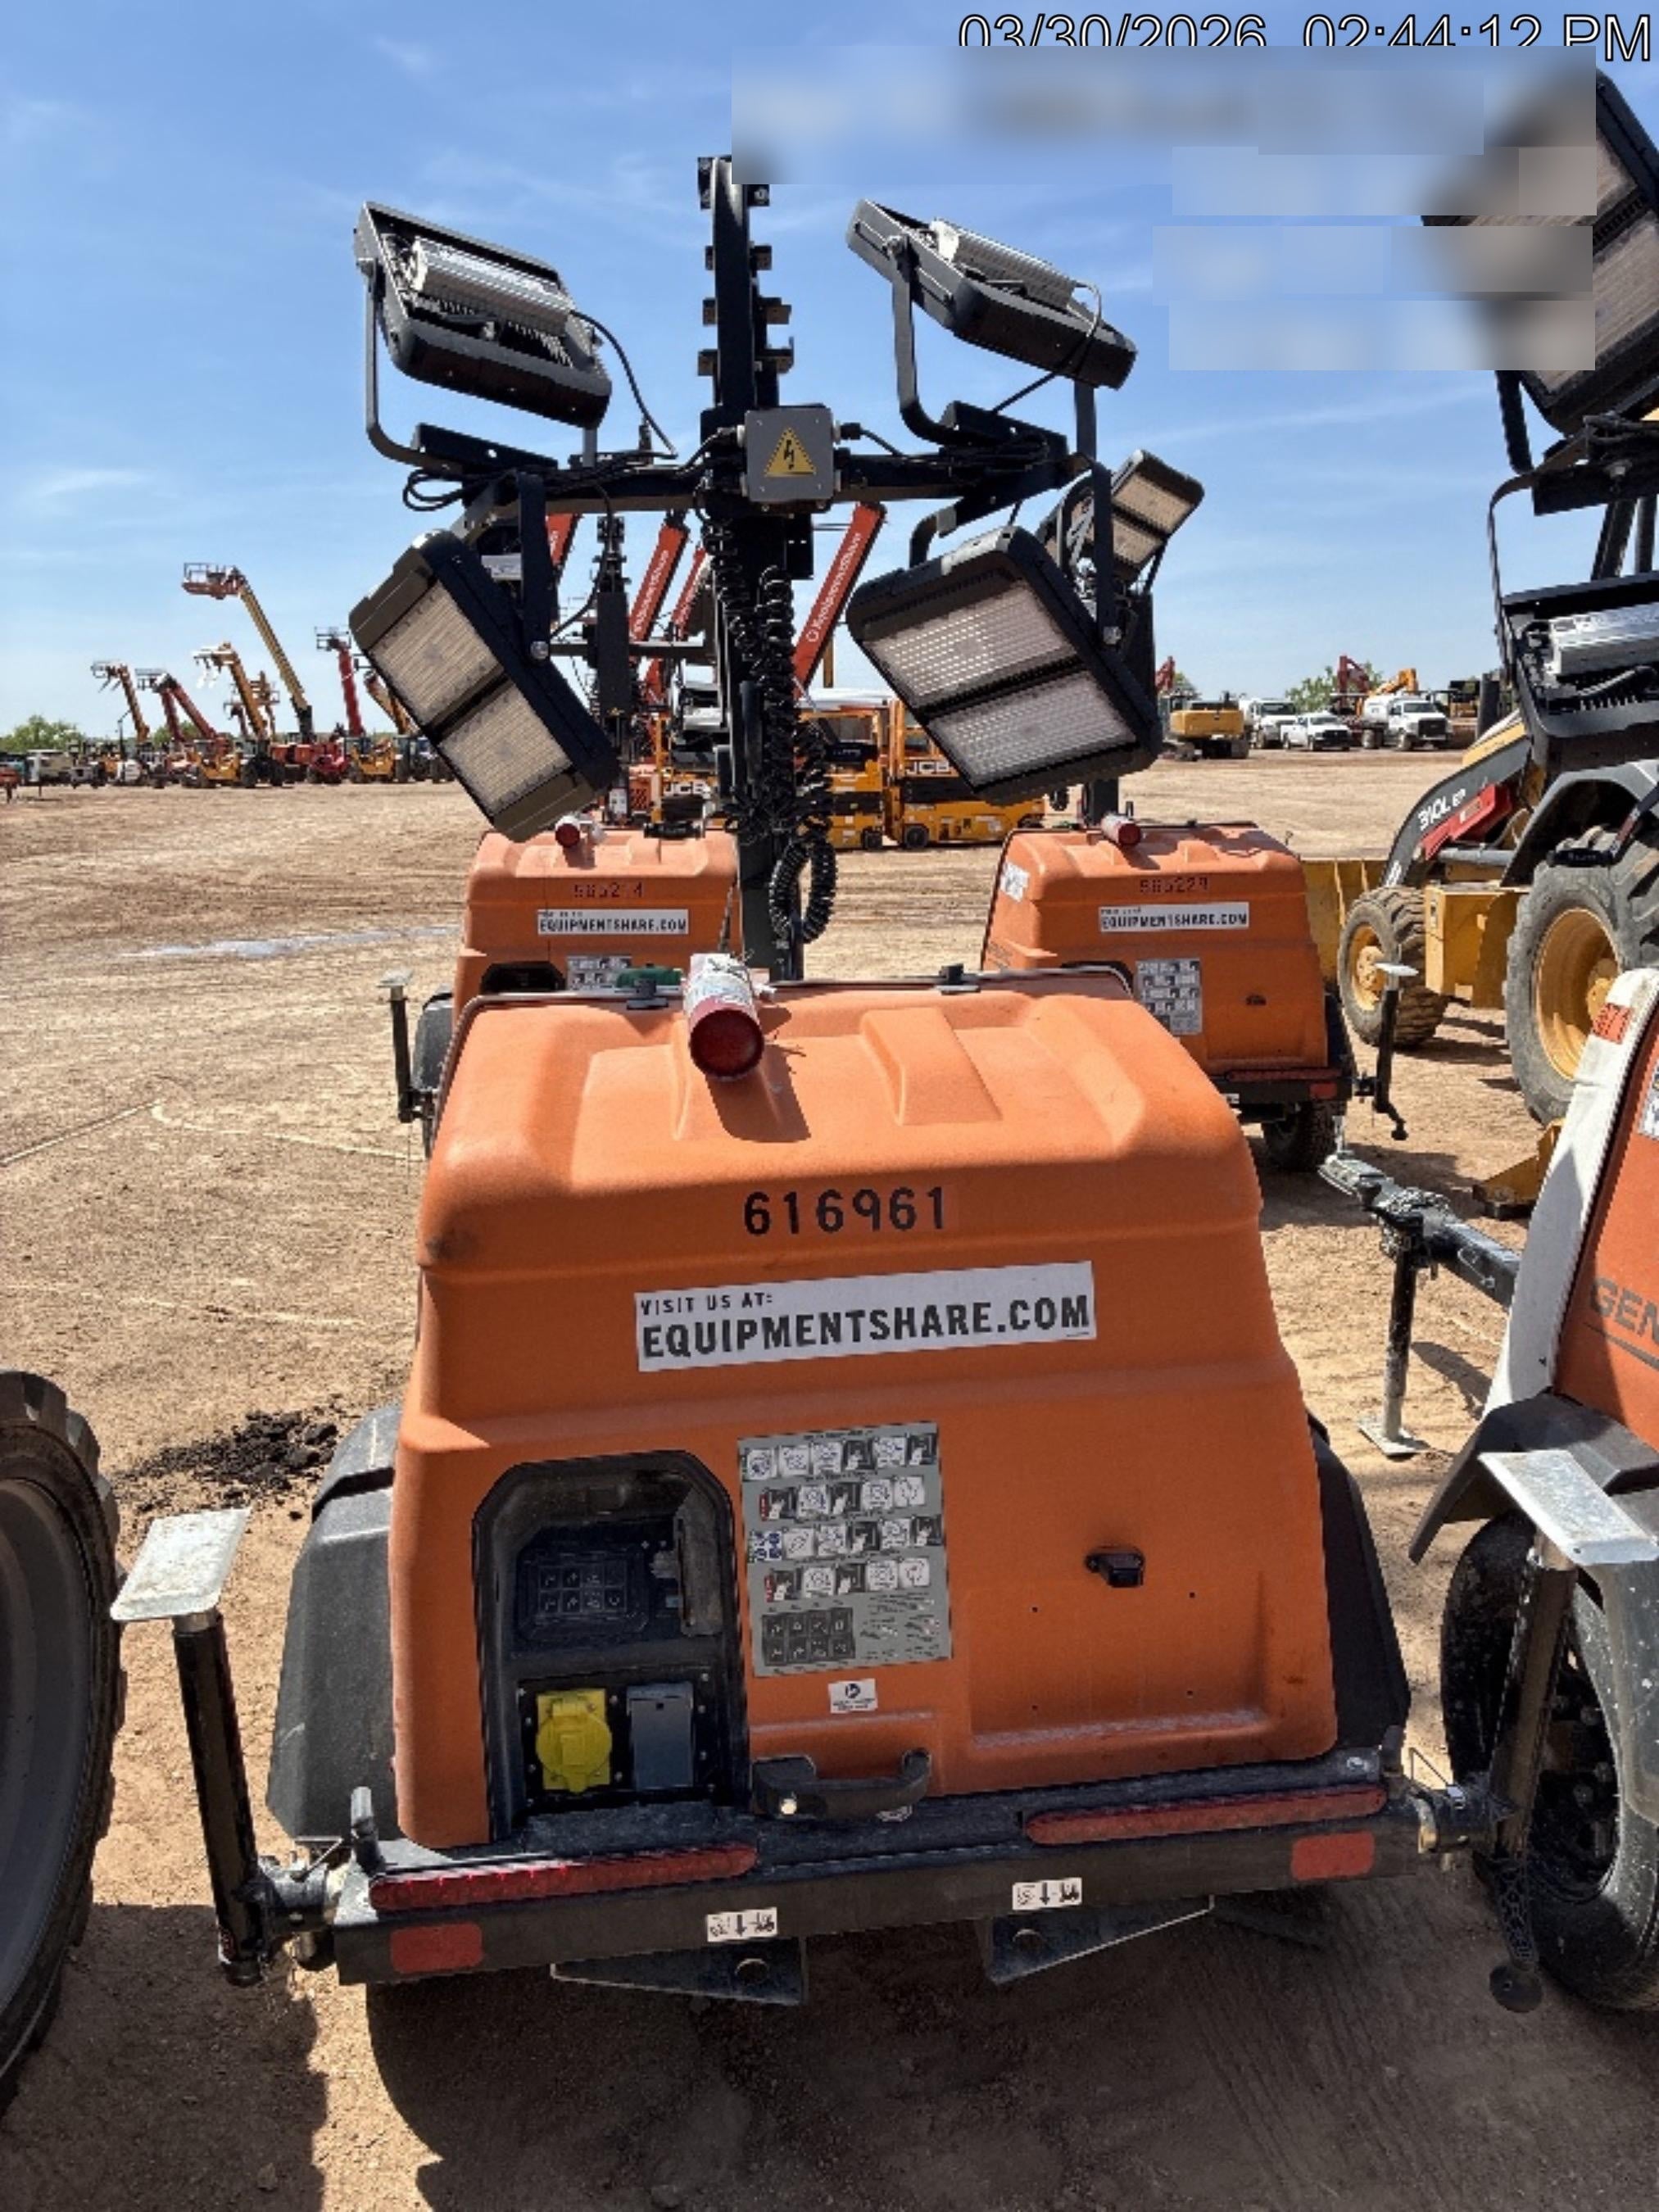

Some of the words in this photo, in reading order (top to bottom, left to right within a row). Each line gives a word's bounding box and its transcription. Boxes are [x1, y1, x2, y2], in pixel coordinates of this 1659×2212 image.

[744, 1186, 944, 1236] 616961
[641, 1297, 695, 1316] VISIT
[707, 1294, 731, 1311] US
[741, 1292, 773, 1308] AT:
[642, 1294, 1090, 1359] EQUIPMENTSHARE.COM
